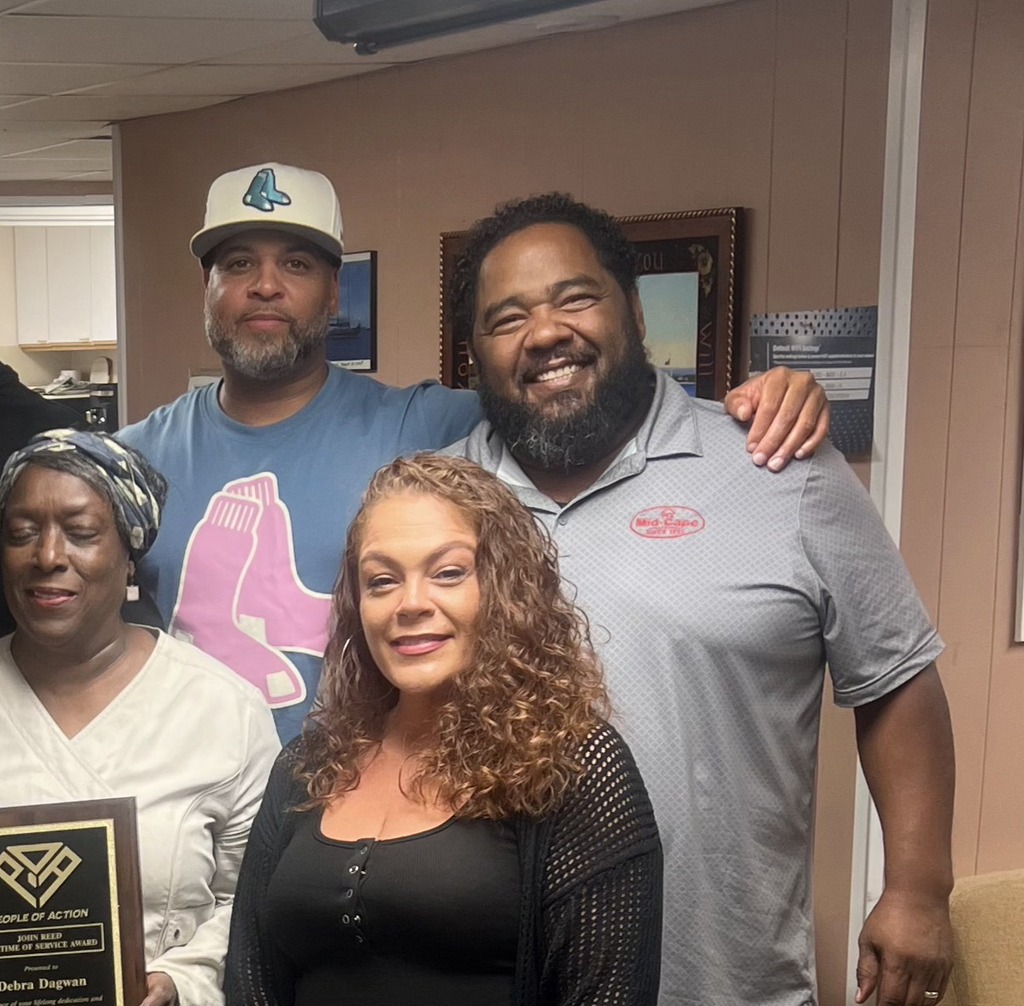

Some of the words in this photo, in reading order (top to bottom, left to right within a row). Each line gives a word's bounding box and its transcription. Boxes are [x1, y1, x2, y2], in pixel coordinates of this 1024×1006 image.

[31, 912, 45, 921] OF
[47, 908, 89, 920] ACTION
[17, 933, 39, 943] JOHN
[40, 932, 63, 940] REED
[22, 943, 33, 951] OF
[35, 941, 68, 950] SERVICE
[70, 938, 98, 947] AWARD
[39, 977, 87, 990] Dagwan
